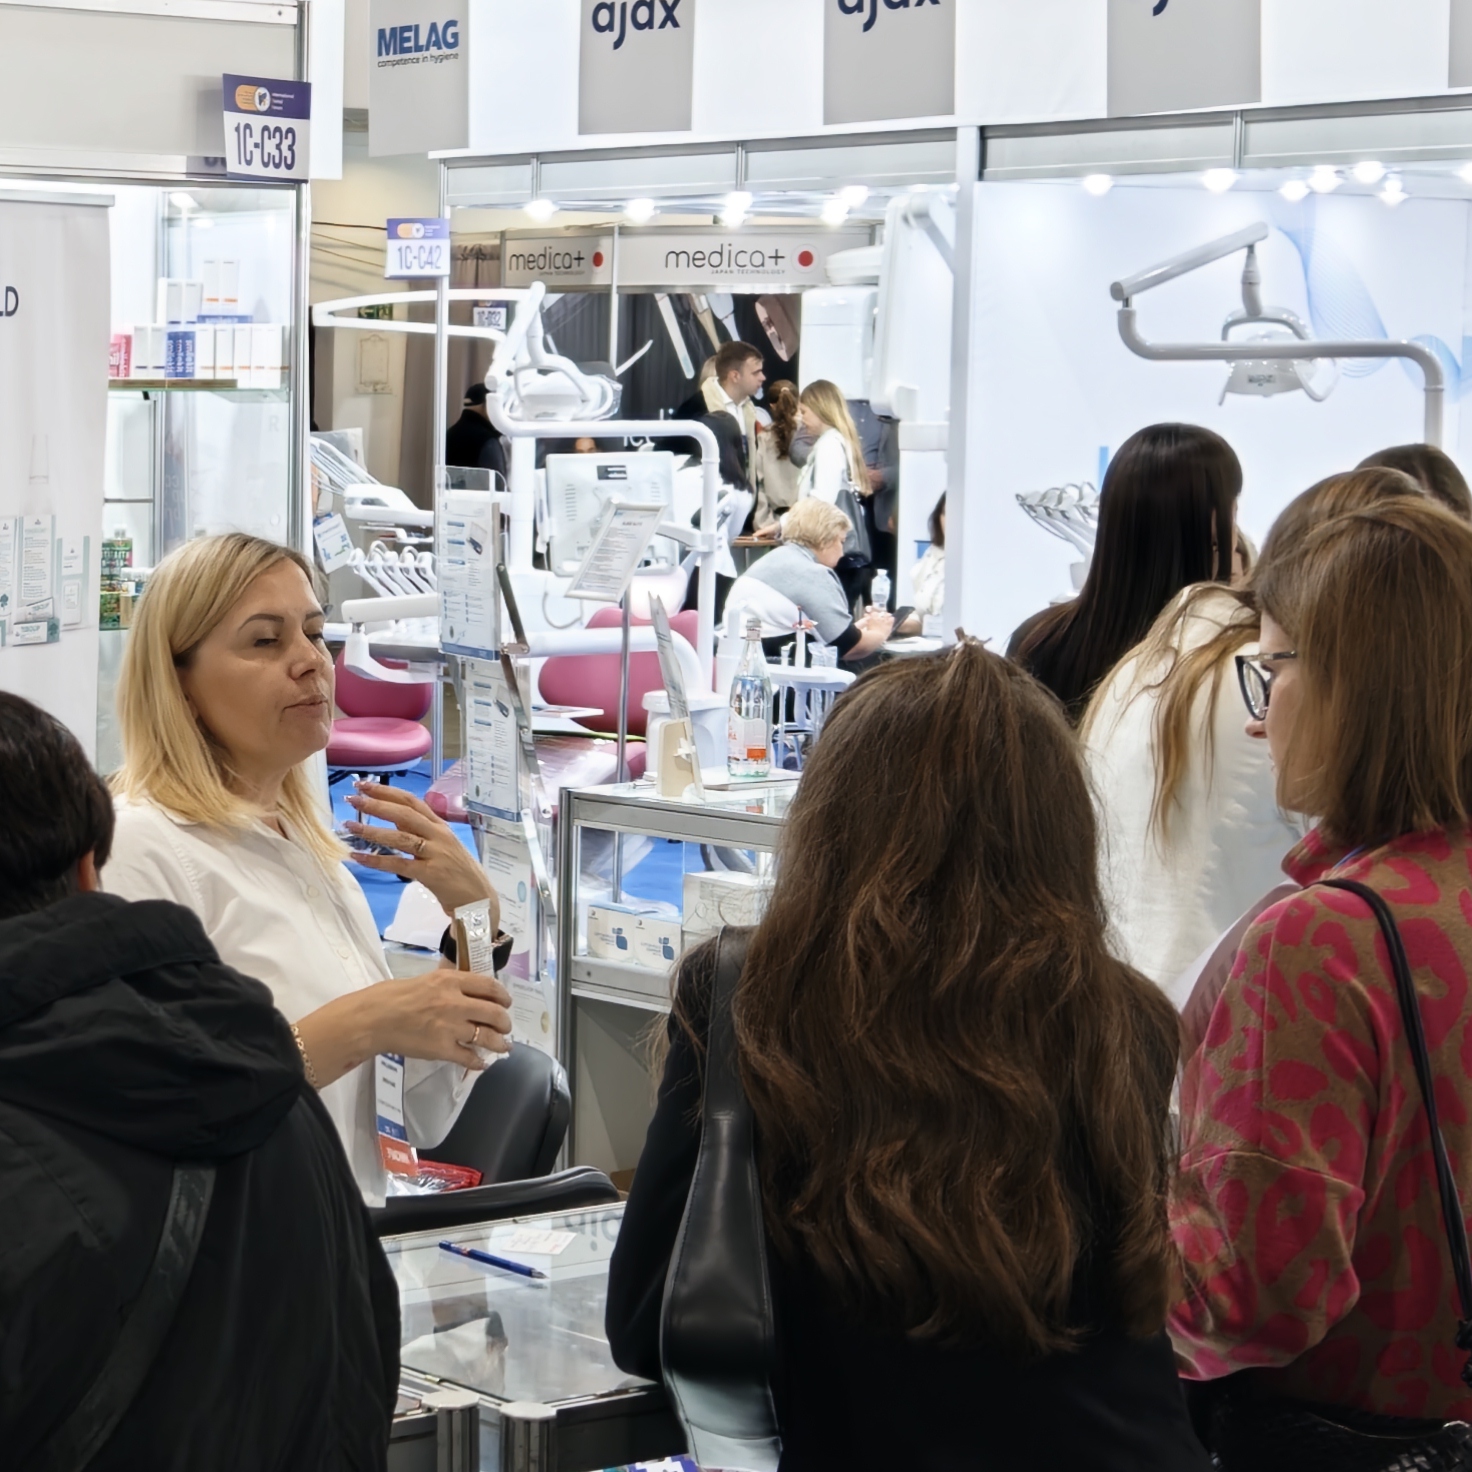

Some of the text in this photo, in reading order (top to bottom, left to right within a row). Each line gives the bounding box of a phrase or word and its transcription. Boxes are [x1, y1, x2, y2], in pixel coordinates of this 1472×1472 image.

[378, 20, 458, 56] MELAG
[235, 122, 296, 170] 1C-C33
[397, 245, 441, 270] 1C-C42
[510, 246, 585, 271] medica+
[665, 243, 785, 269] medica+
